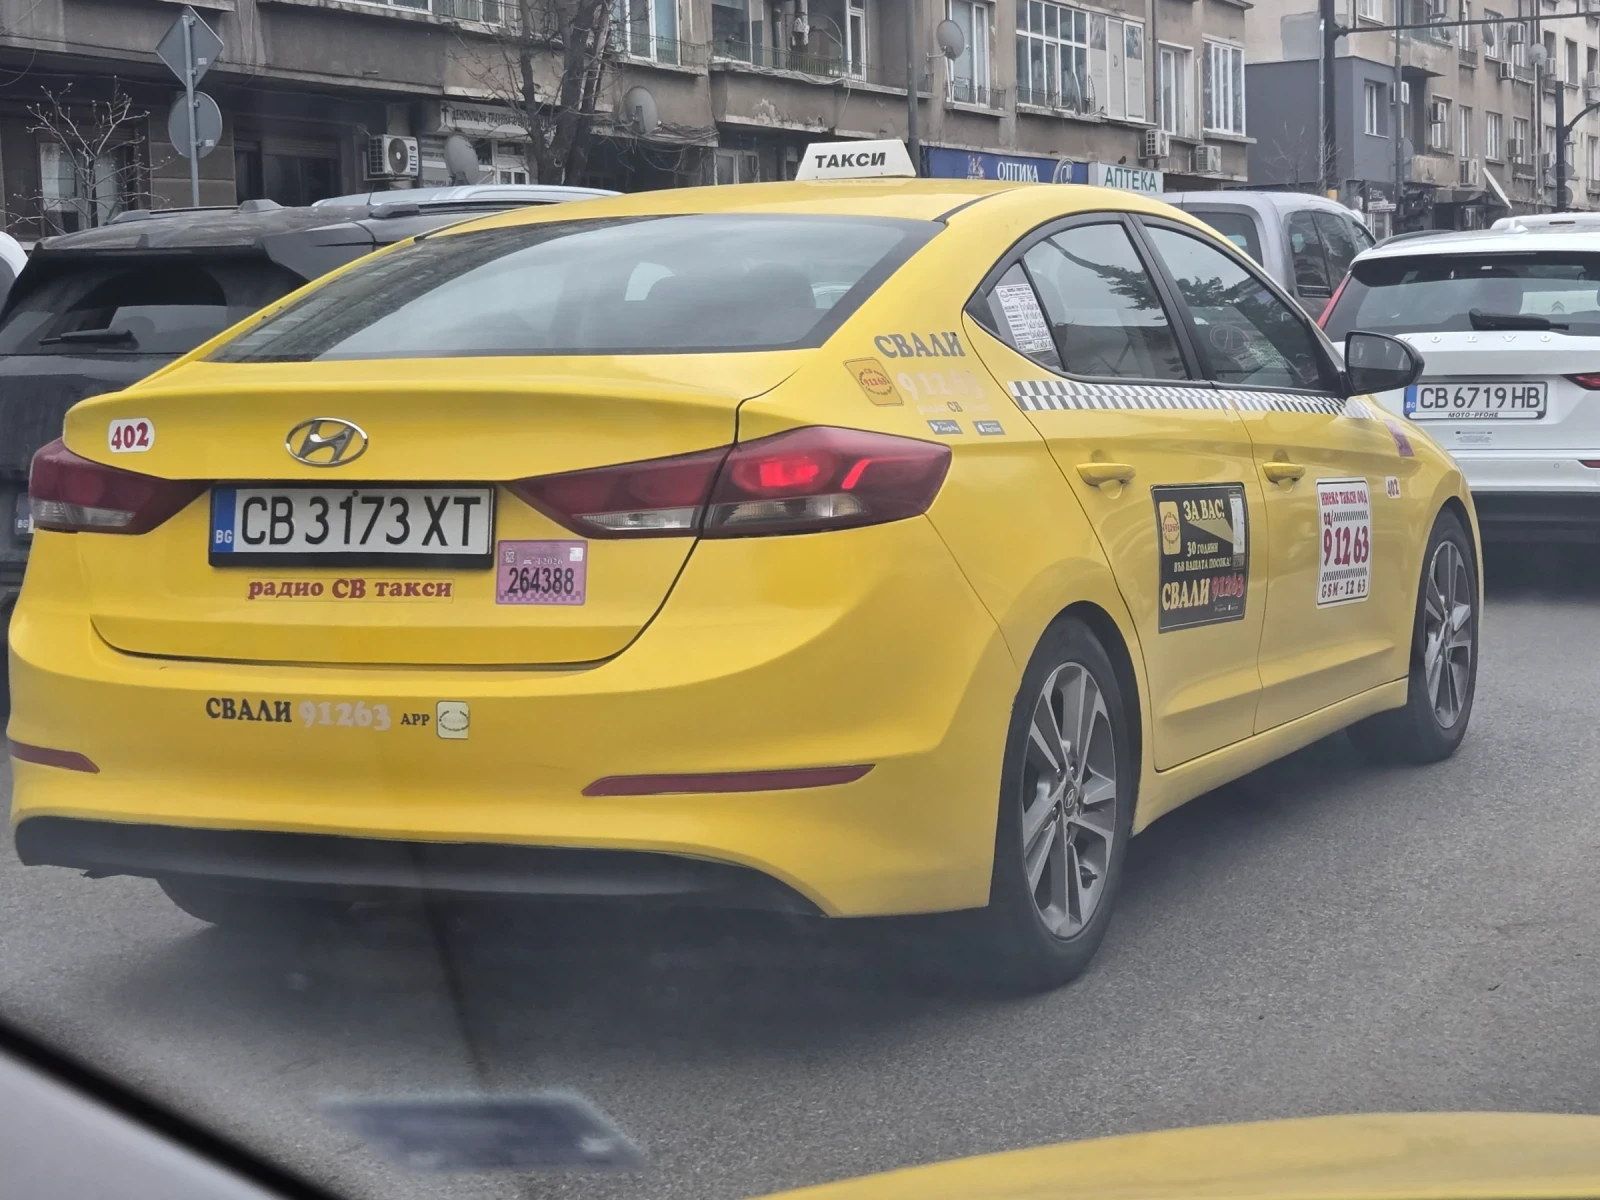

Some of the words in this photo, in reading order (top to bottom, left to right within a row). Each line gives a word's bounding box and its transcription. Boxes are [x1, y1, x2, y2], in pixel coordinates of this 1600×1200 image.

[815, 152, 887, 169] ТАКСИ
[997, 162, 1040, 183] ОПТИКА
[1104, 166, 1159, 193] АПТЕКА
[874, 332, 966, 358] СВАЛИ
[947, 401, 963, 412] СВ
[1453, 387, 1507, 409] 6719
[111, 422, 149, 449] 402
[1387, 479, 1400, 498] 402
[304, 495, 411, 546] 3173
[1183, 500, 1199, 521] ЗА
[1202, 498, 1225, 519] ВАС!
[215, 529, 233, 544] BG
[1187, 541, 1196, 557] 30
[248, 580, 323, 600] радио
[332, 578, 366, 599] СВ
[375, 581, 452, 598] такси
[507, 567, 574, 595] 264388
[1162, 578, 1210, 611] СВАЛИ
[1211, 572, 1245, 602] 91263
[206, 697, 292, 723] СВАЛИ
[298, 700, 391, 731] 91263
